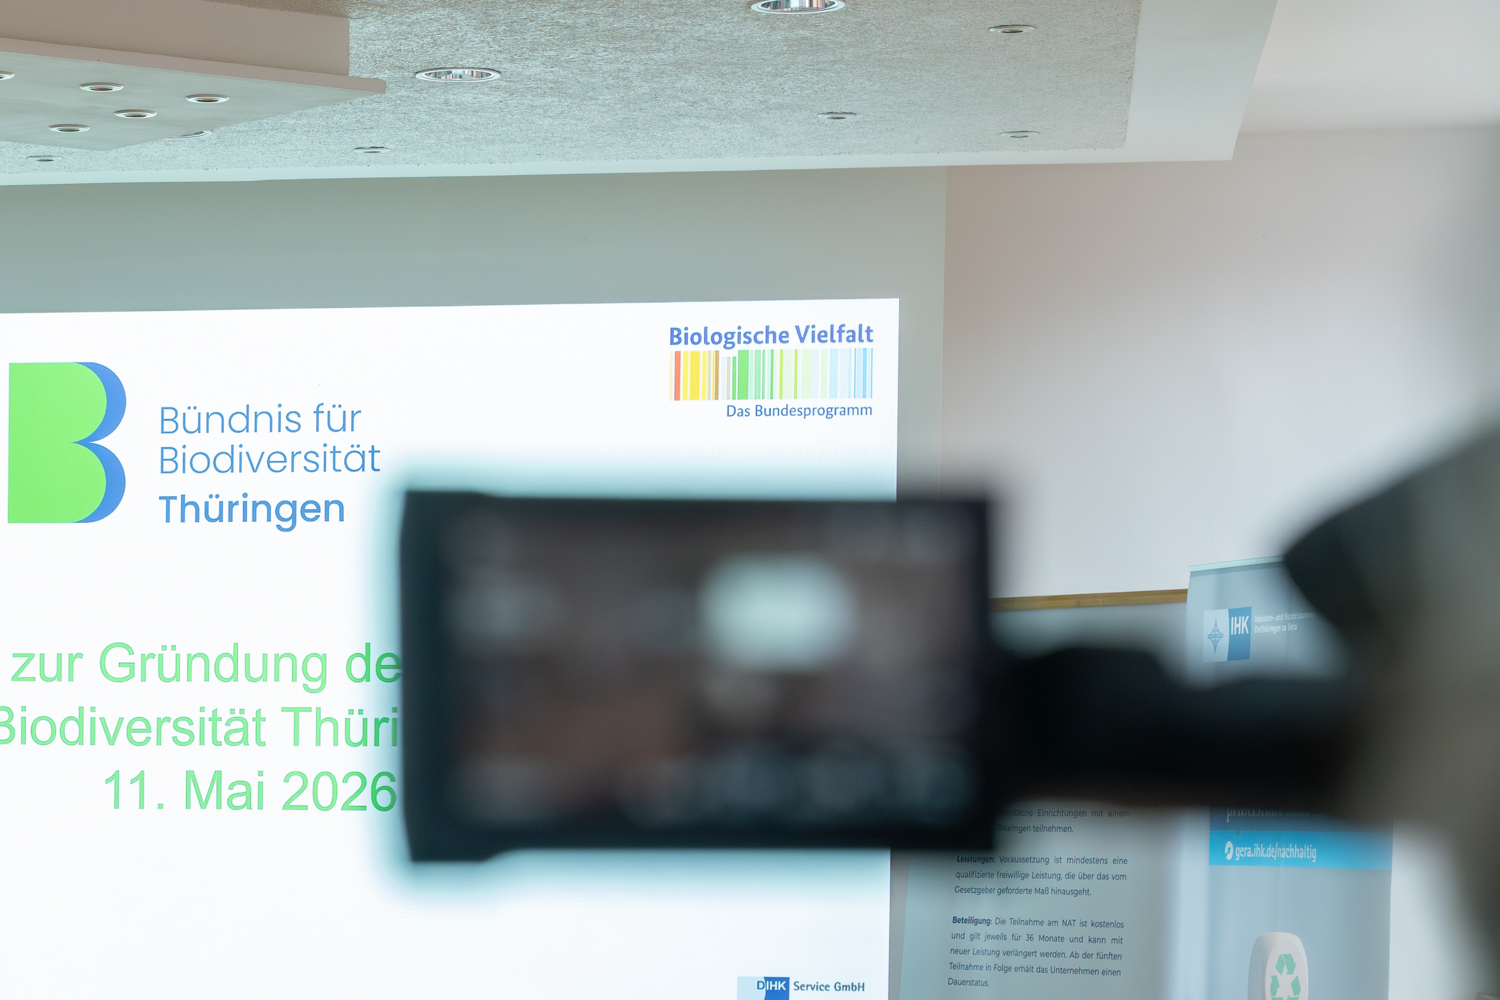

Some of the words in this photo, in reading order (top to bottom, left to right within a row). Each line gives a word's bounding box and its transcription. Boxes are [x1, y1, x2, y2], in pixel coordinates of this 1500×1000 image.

[669, 325, 790, 350] Biologische
[794, 323, 874, 344] Vielfalt
[159, 403, 302, 435] Bündnis
[312, 402, 362, 433] für
[726, 404, 751, 418] Das
[754, 404, 873, 420] Bundesprogramm
[159, 443, 381, 474] Biodiversität
[158, 492, 345, 532] Thüringen
[1230, 615, 1250, 636] IHK
[1288, 622, 1298, 632] Gera
[10, 651, 83, 683] zur
[98, 642, 328, 694] Gründung
[345, 642, 400, 684] de
[280, 706, 399, 748] Thüri
[104, 769, 164, 810] 11.
[184, 770, 264, 811] Mai
[281, 770, 397, 812] 2026
[1037, 808, 1087, 819] Einrichtungen
[1032, 824, 1074, 833] teilnehmen.
[1235, 842, 1317, 863] gera.ihk.de/nachhaltig
[999, 856, 1050, 866] Voraussetzung
[1054, 856, 1062, 864] ist
[1066, 856, 1108, 865] mindestens
[1112, 857, 1128, 865] eine
[956, 870, 995, 880] qualifizierte
[996, 870, 1030, 881] freiwillige
[1032, 871, 1063, 882] Leistung,
[1064, 872, 1076, 880] die
[1078, 872, 1094, 881] über
[1096, 872, 1110, 881] das
[954, 885, 996, 896] Gesetzgeber
[997, 886, 1033, 896] geforderte
[1034, 886, 1050, 896] Maß
[1050, 886, 1092, 898] hinausgeht.
[952, 916, 992, 927] Beteiligung:
[994, 916, 1007, 926] Die
[1009, 918, 1045, 928] Teilnahme
[1047, 920, 1059, 928] am
[1062, 919, 1077, 928] NAT
[1079, 918, 1088, 928] ist
[1090, 920, 1125, 929] kostenlos
[951, 932, 966, 941] und
[969, 932, 981, 942] gilt
[984, 932, 1008, 943] jeweils
[1011, 932, 1022, 942] für
[1025, 934, 1035, 942] 36
[1038, 934, 1066, 944] Monate
[1069, 935, 1084, 944] und
[1088, 936, 1107, 944] kann
[1110, 936, 1124, 945] mit
[950, 948, 971, 956] neuer
[972, 948, 1001, 958] Leistung
[1002, 948, 1038, 960] verlängert
[1040, 950, 1068, 959] werden.
[1069, 950, 1080, 960] Ab
[1082, 951, 1094, 960] der
[1096, 952, 1122, 961] fünften
[948, 962, 984, 972] Teilnahme
[986, 963, 992, 972] in
[994, 964, 1013, 974] Folge
[1014, 964, 1034, 974] erhält
[1036, 965, 1048, 974] das
[1050, 966, 1100, 976] Unternehmen
[1101, 968, 1122, 976] einen
[756, 980, 787, 991] DIHK
[794, 981, 831, 992] Service
[834, 982, 866, 992] GmbH
[948, 978, 990, 988] Dauerstatus.
